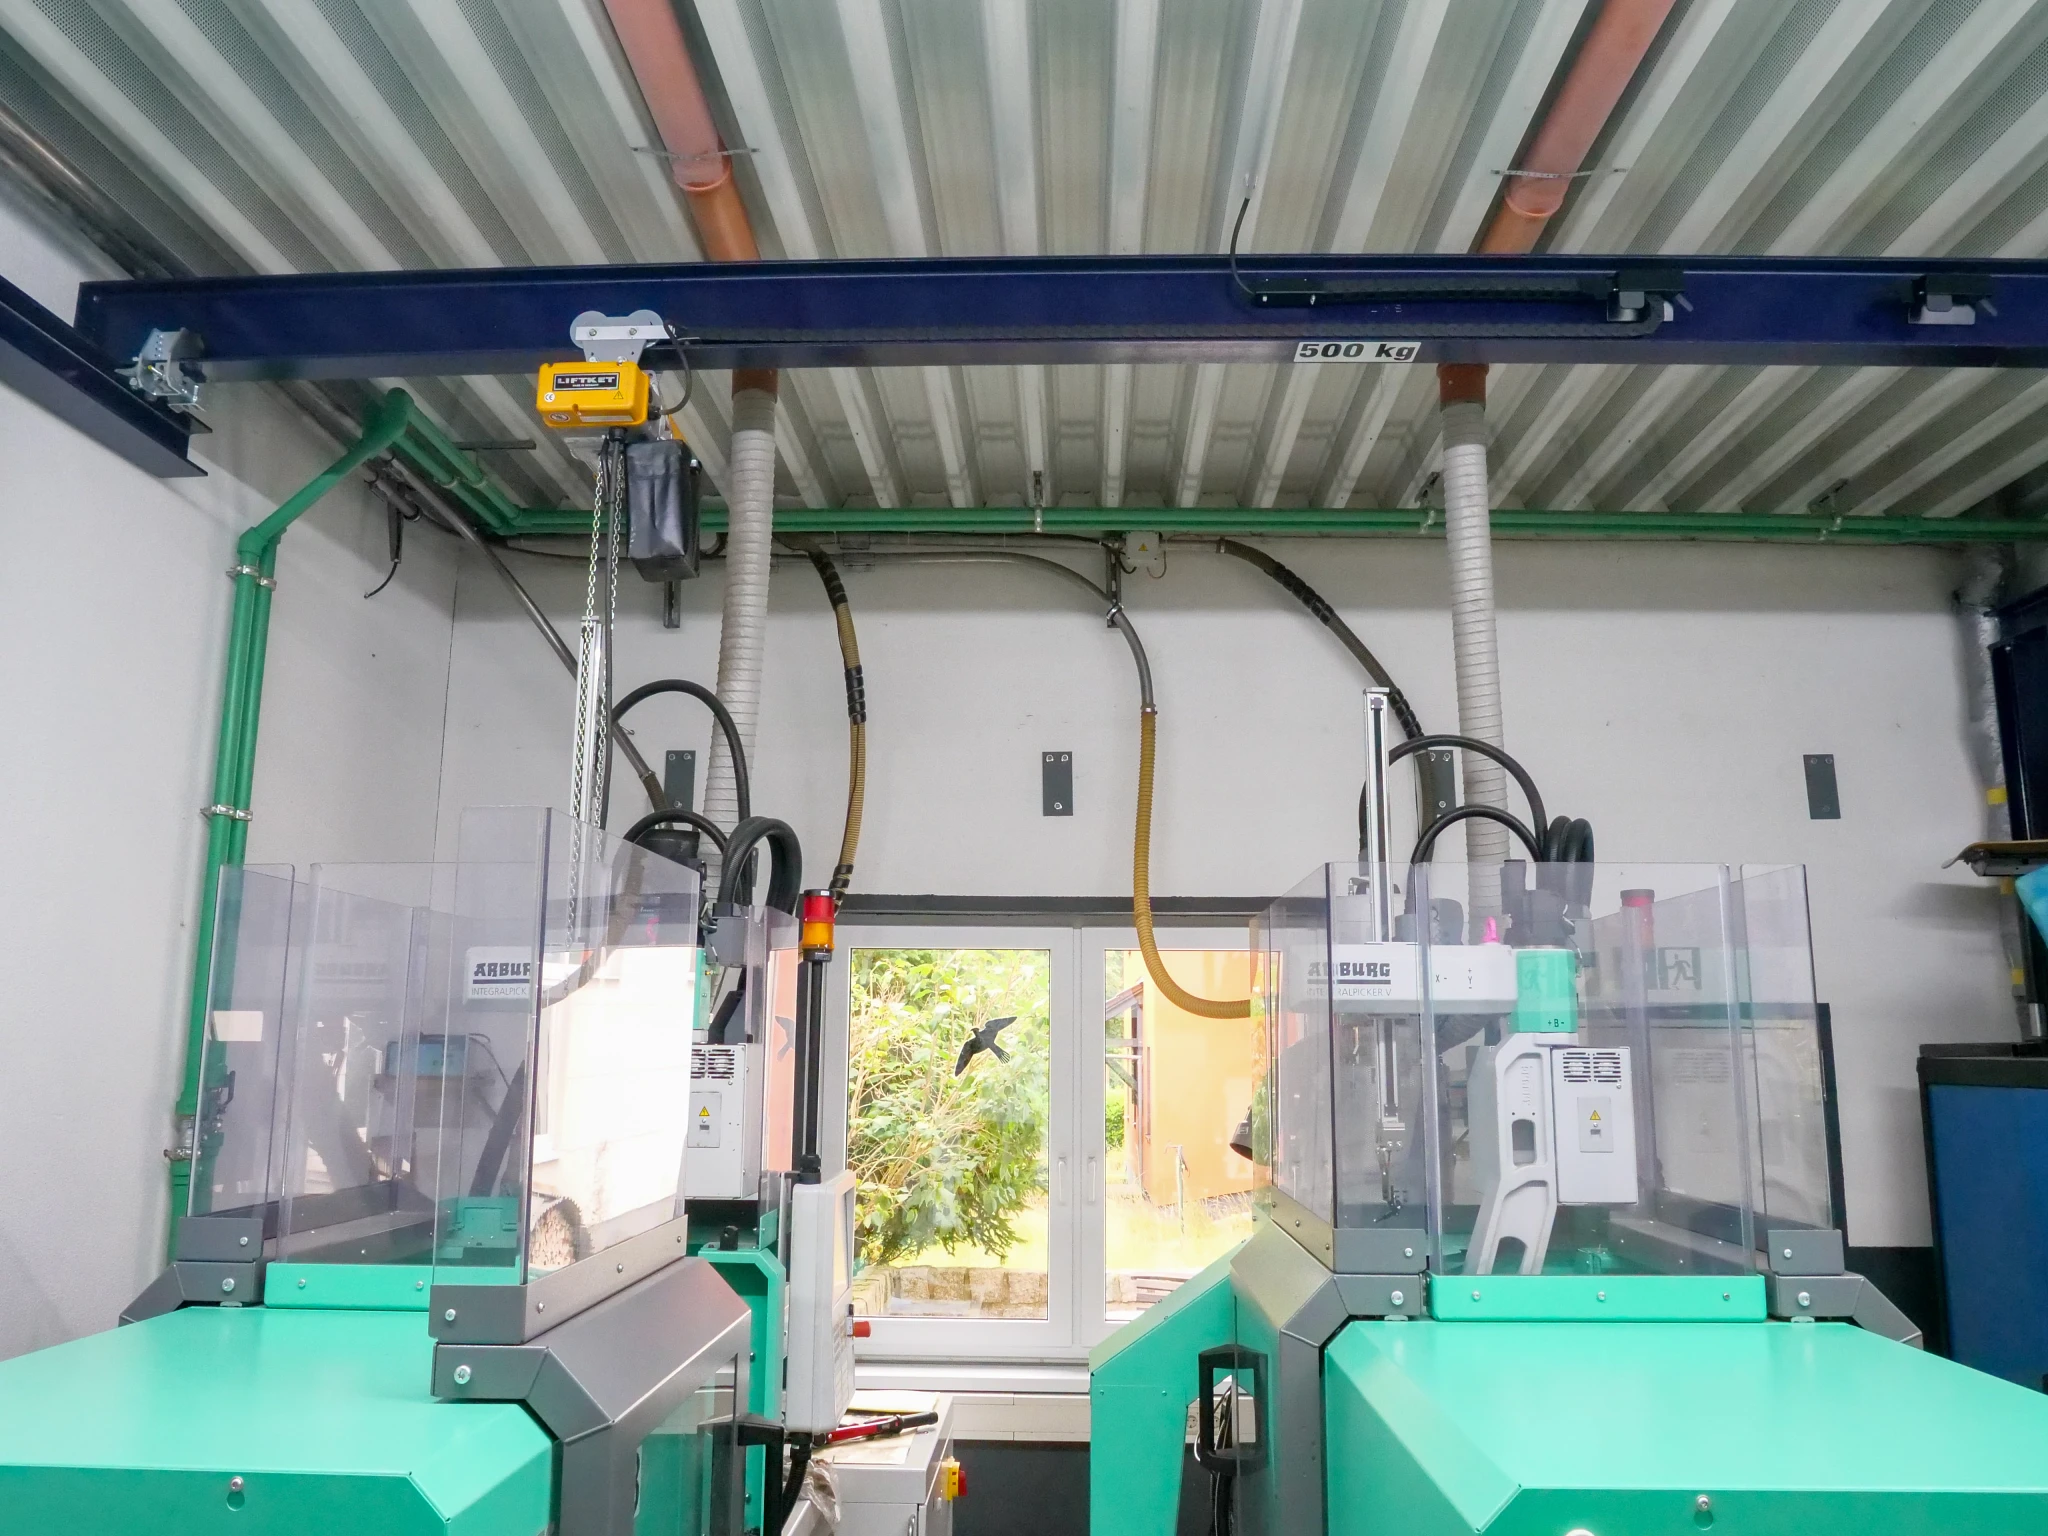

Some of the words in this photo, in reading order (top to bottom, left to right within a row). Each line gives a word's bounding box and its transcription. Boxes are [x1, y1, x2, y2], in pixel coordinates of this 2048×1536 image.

[1299, 343, 1364, 358] 500
[1375, 343, 1416, 361] kg
[557, 376, 615, 384] LIFTKET
[474, 962, 530, 977] ARBUR
